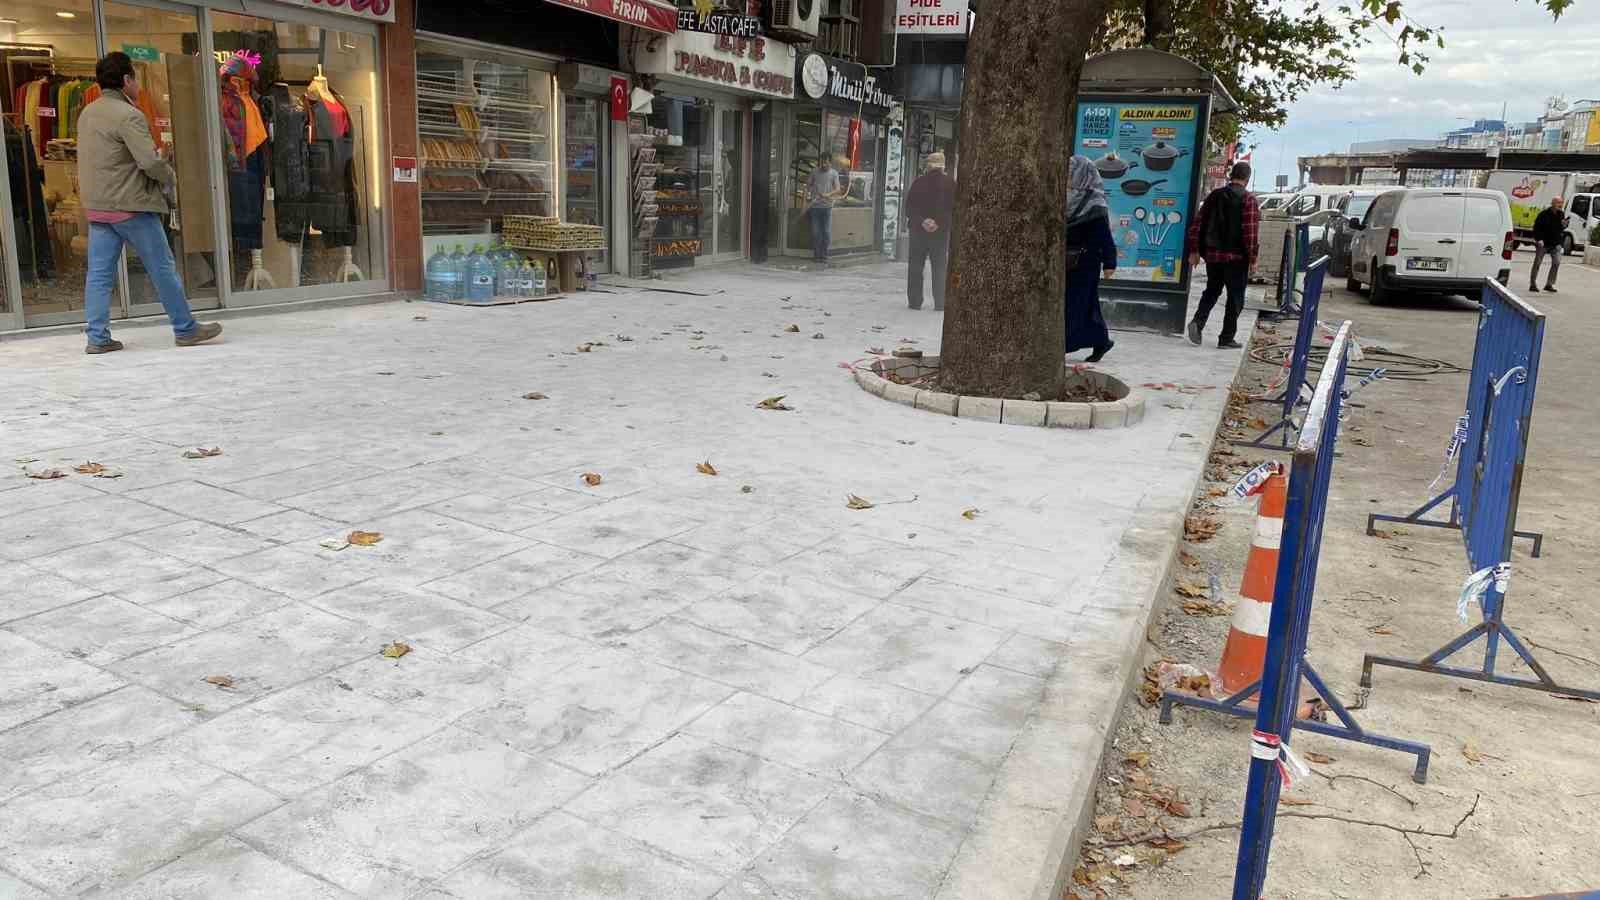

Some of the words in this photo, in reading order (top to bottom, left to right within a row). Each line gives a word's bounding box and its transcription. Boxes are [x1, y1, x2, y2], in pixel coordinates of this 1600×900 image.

[731, 18, 756, 36] CAFE
[1122, 109, 1154, 119] ALDIN
[1155, 109, 1192, 119] ALDIN!
